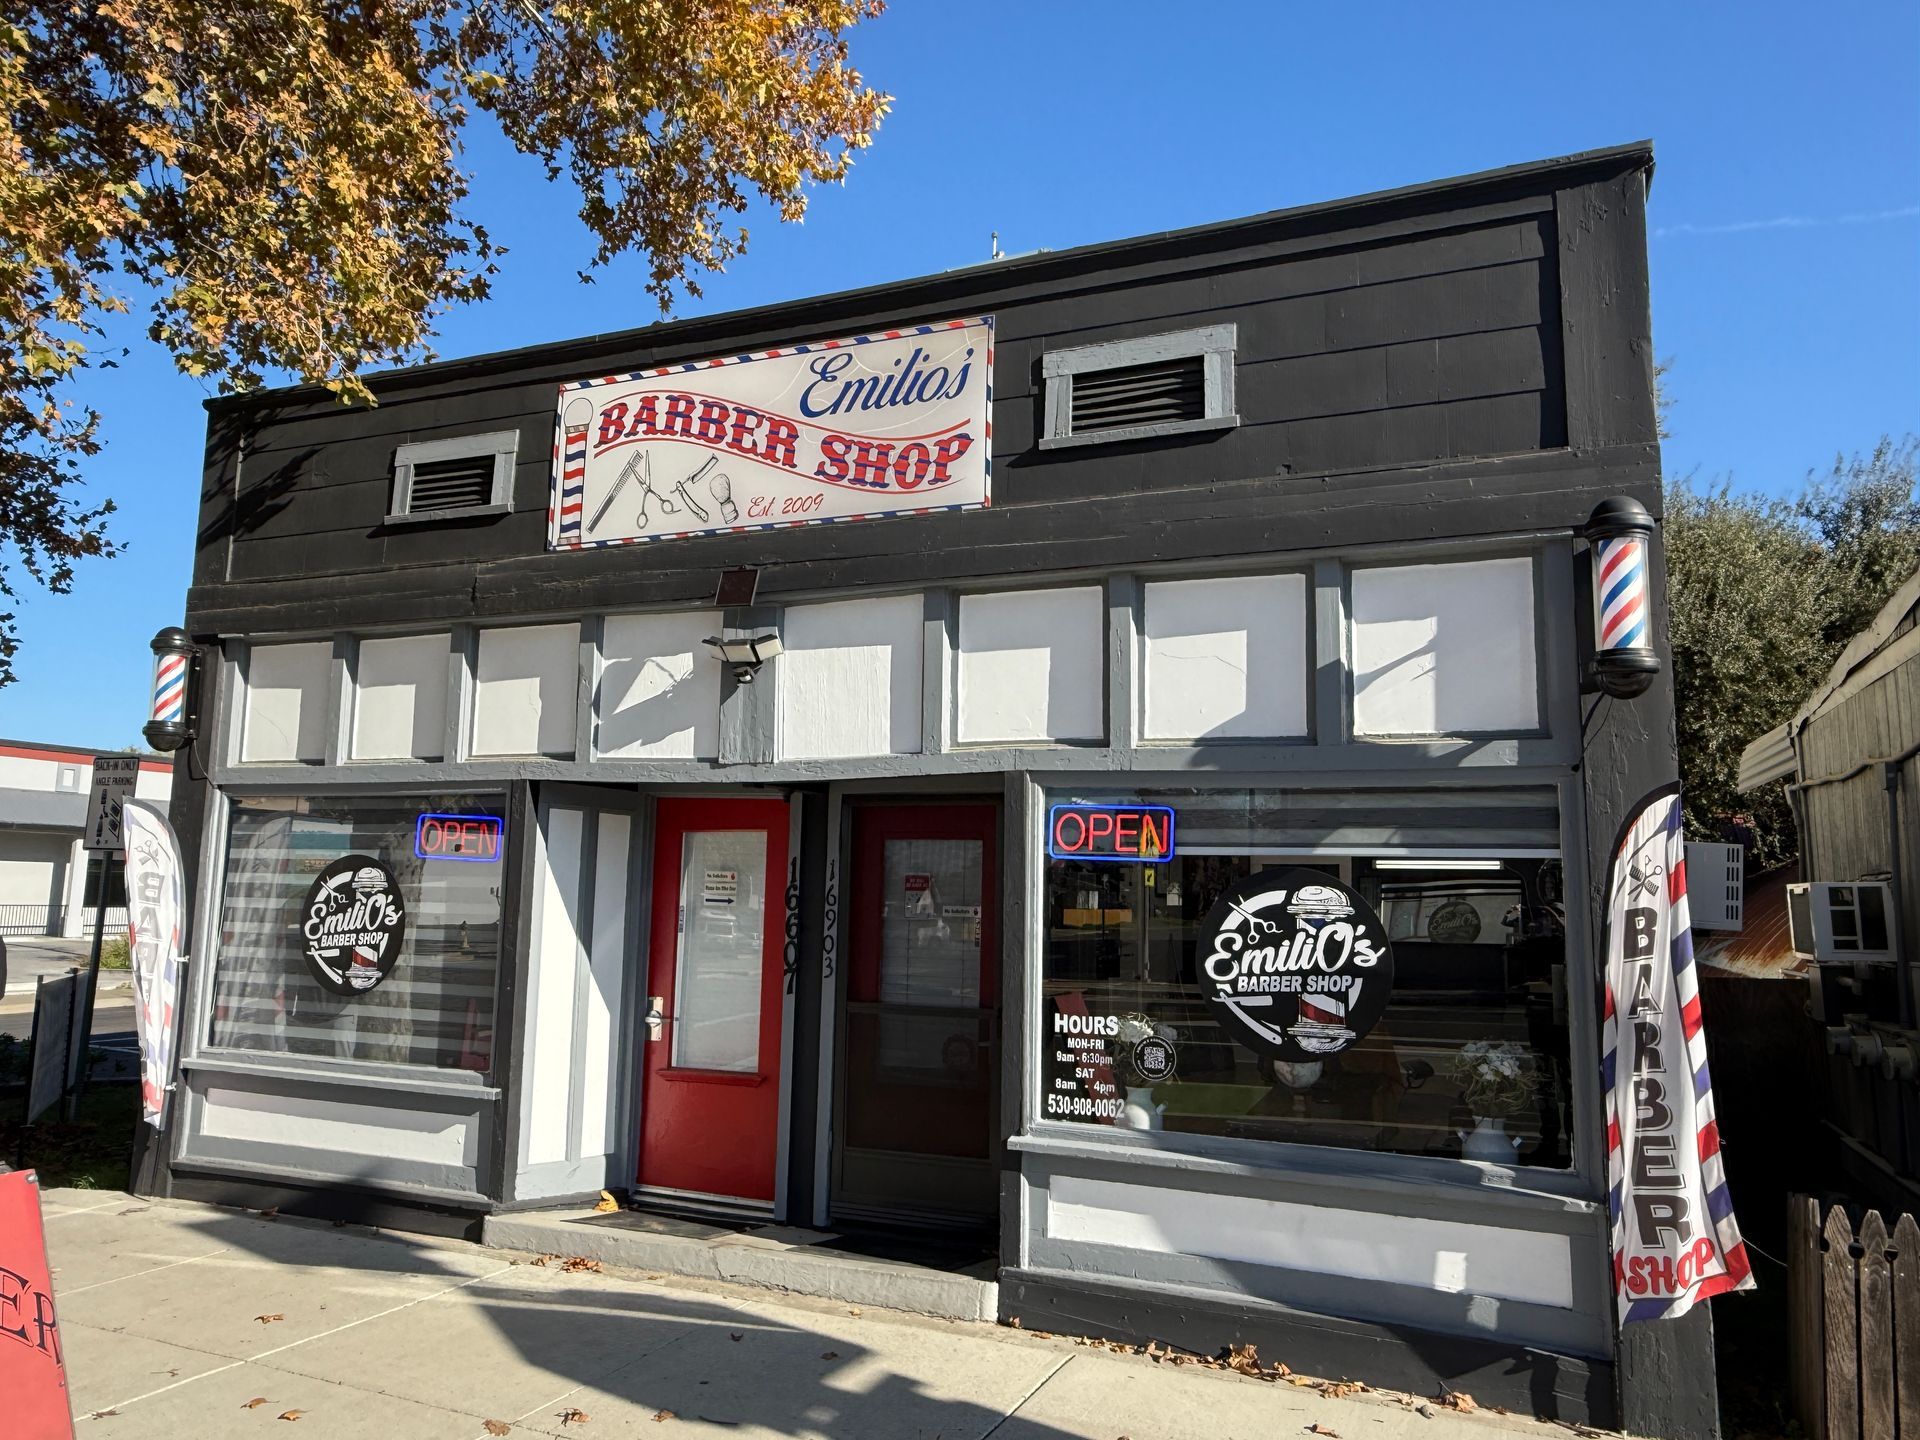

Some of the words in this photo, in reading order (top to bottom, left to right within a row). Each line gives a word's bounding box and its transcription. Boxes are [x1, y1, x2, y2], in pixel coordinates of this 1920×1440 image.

[593, 394, 799, 468] BARBER
[814, 432, 975, 489] SHOP
[747, 497, 775, 518] Est.
[782, 494, 824, 514] 2009
[421, 819, 499, 855] OPEN
[1055, 812, 1168, 853] OPEN
[304, 893, 403, 940] EmiliO's
[823, 859, 837, 979] 16903
[321, 933, 357, 948] BARBER
[357, 931, 384, 946] SHOP
[1204, 921, 1387, 981] EmiliO's
[1237, 976, 1303, 992] BARBER
[1306, 975, 1353, 992] SHOP
[1054, 1013, 1119, 1036] HOURS
[1067, 1037, 1105, 1050] MON-FRI
[1056, 1050, 1075, 1063] 9am
[1081, 1052, 1113, 1067] 6:30pm
[1075, 1067, 1096, 1079] SAT
[1623, 906, 1694, 1249] BARBER
[1055, 1078, 1077, 1090] 8am
[1093, 1080, 1116, 1095] 4pm
[1047, 1093, 1125, 1119] 530-908-0062
[1627, 1237, 1716, 1297] SHOP
